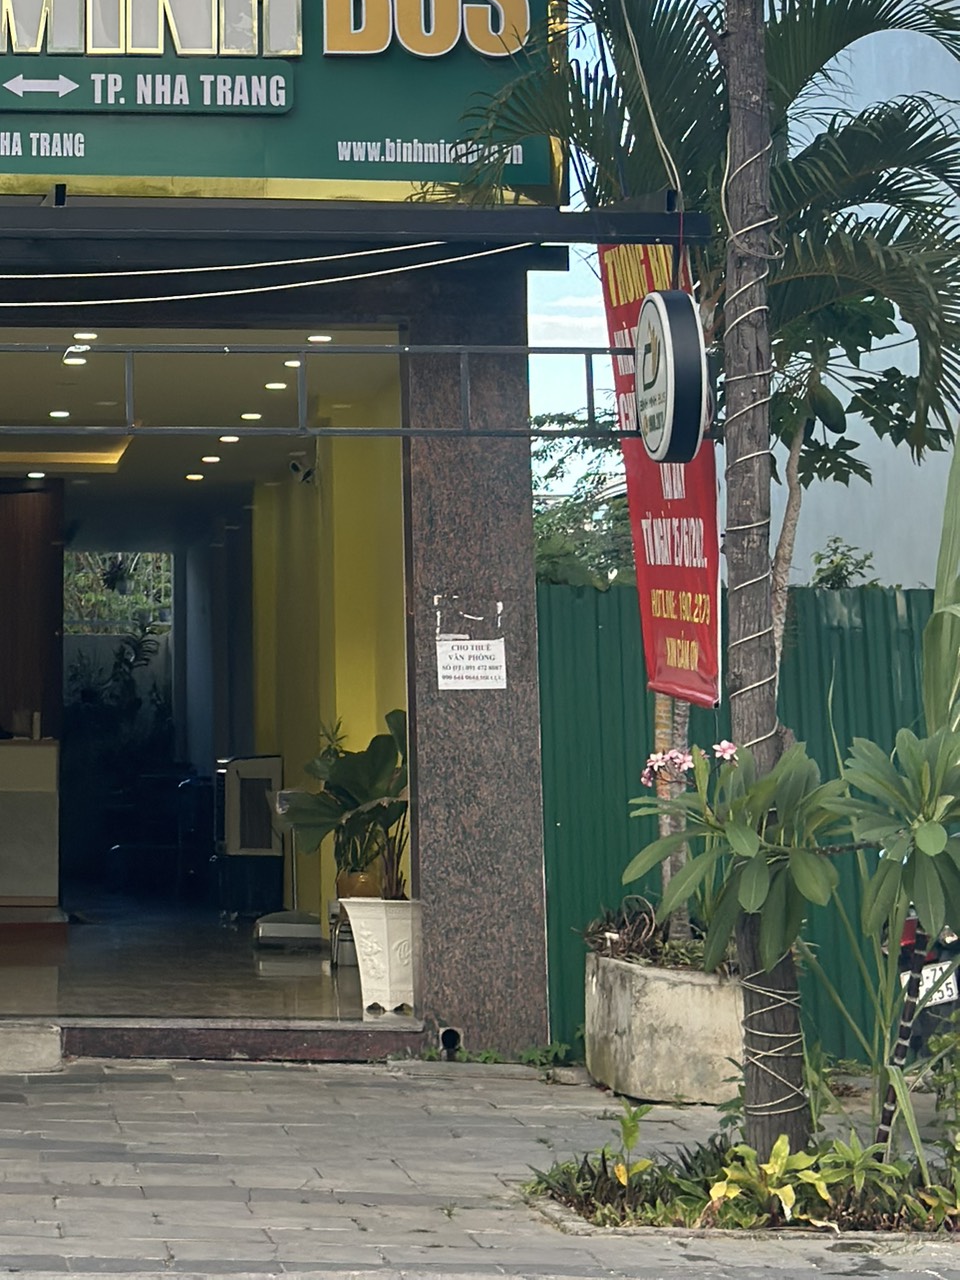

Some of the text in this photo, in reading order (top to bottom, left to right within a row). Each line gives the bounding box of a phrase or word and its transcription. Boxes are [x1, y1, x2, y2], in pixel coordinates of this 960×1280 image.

[91, 74, 286, 107] TP. NHA TRANG
[30, 133, 85, 157] TRANG
